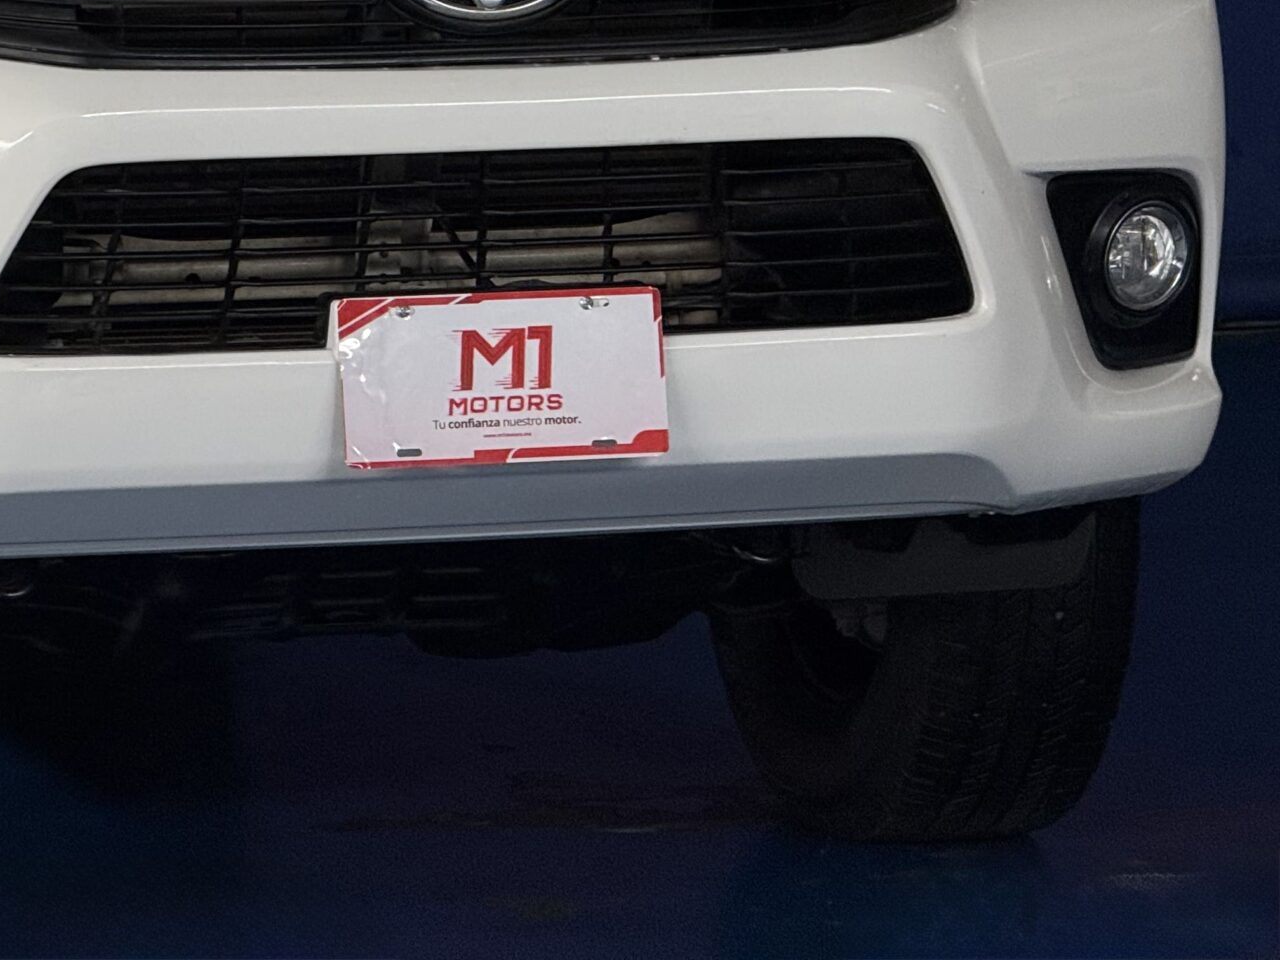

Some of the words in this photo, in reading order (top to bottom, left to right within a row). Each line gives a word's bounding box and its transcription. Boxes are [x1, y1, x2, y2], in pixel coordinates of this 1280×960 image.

[451, 325, 552, 391] M1
[448, 394, 563, 416] MOTORS
[432, 419, 446, 430] Tu
[448, 417, 501, 429] confianza
[502, 416, 542, 428] nuestro
[544, 415, 582, 426] motor.
